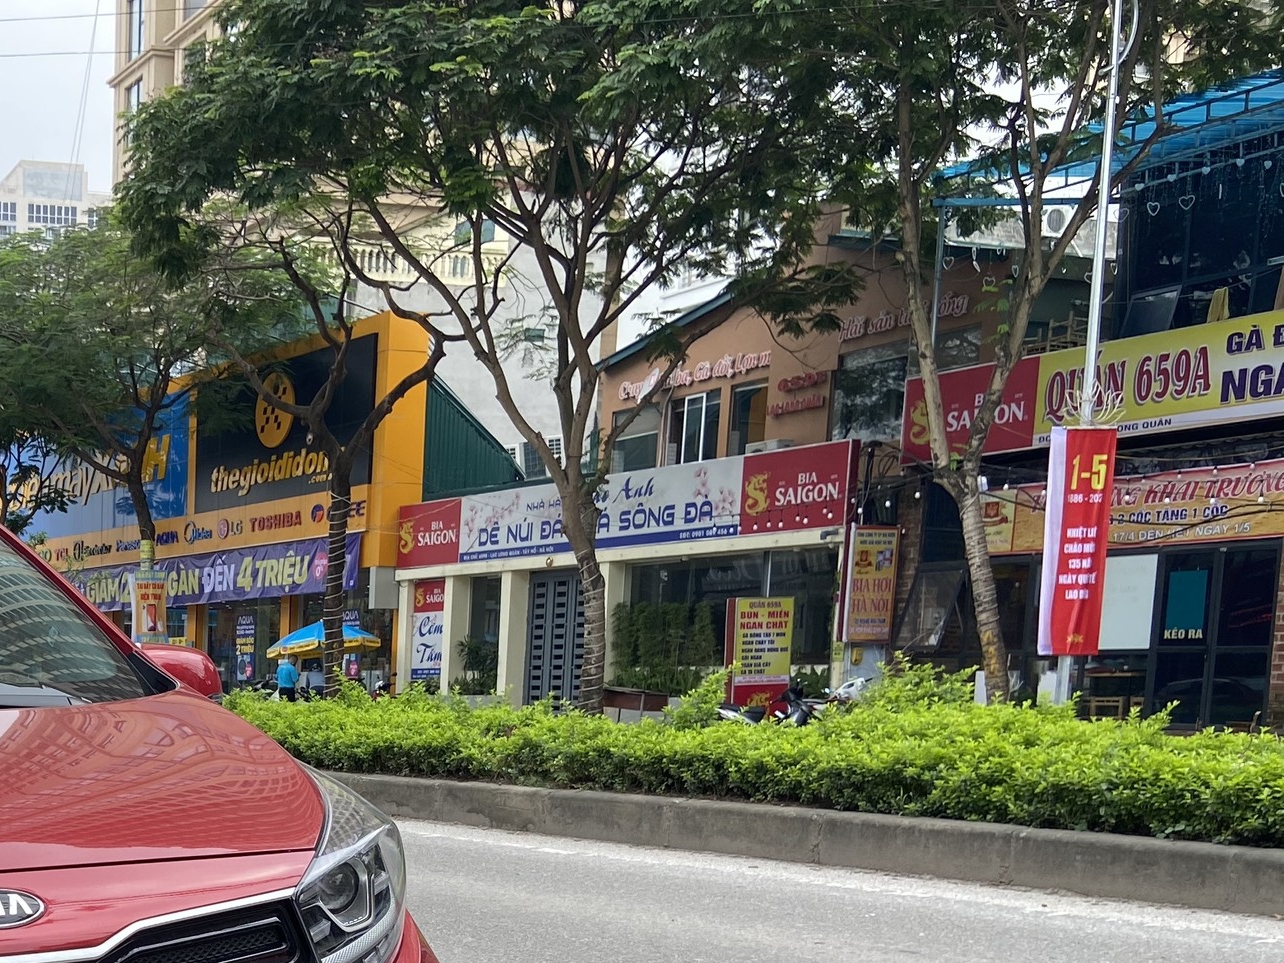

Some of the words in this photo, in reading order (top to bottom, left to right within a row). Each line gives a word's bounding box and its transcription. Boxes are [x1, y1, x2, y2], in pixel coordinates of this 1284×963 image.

[1226, 324, 1264, 356] GÀ
[1045, 349, 1128, 423] QUÁN
[1134, 345, 1212, 405] 659A
[946, 401, 1025, 432] SAION
[1117, 423, 1139, 434] ONG
[1142, 418, 1172, 430] QUÂN
[211, 447, 331, 497] thegioididon
[797, 471, 818, 485] BIA
[1070, 454, 1108, 491] 1-5
[774, 481, 840, 506] SAIGON
[1090, 494, 1102, 503] 202
[1110, 485, 1141, 508] NG
[1144, 480, 1200, 504] KHAI
[526, 499, 545, 511] NHÀ
[597, 506, 611, 534] Á
[618, 502, 676, 532] SÔNG
[683, 494, 713, 524] ĐÀ
[1192, 508, 1197, 518] 1
[116, 540, 141, 552] Panaso
[156, 531, 179, 546] AQUA
[230, 520, 243, 535] LG
[250, 510, 302, 533] TOSHIBA
[327, 500, 366, 523] EE
[432, 521, 444, 530] BIA
[478, 521, 501, 547] DÊ
[506, 516, 533, 544] NÚI
[540, 513, 564, 540] ĐÁ
[1234, 522, 1250, 534] 1/5
[418, 528, 457, 547] SAIGON
[1068, 558, 1081, 569] 135
[166, 564, 200, 598] GÀN
[202, 556, 235, 594] ĐẾN
[236, 556, 254, 592] 4
[256, 550, 310, 594] TRIỆU
[852, 578, 870, 592] BIA
[426, 594, 444, 604] SAIGO
[1065, 589, 1078, 600] LAO
[851, 594, 867, 614] HÀ
[238, 616, 254, 624] AQUA
[740, 621, 764, 630] NGAN
[1164, 626, 1185, 640] KÉO
[1188, 628, 1203, 639] RA
[236, 645, 241, 656] 2
